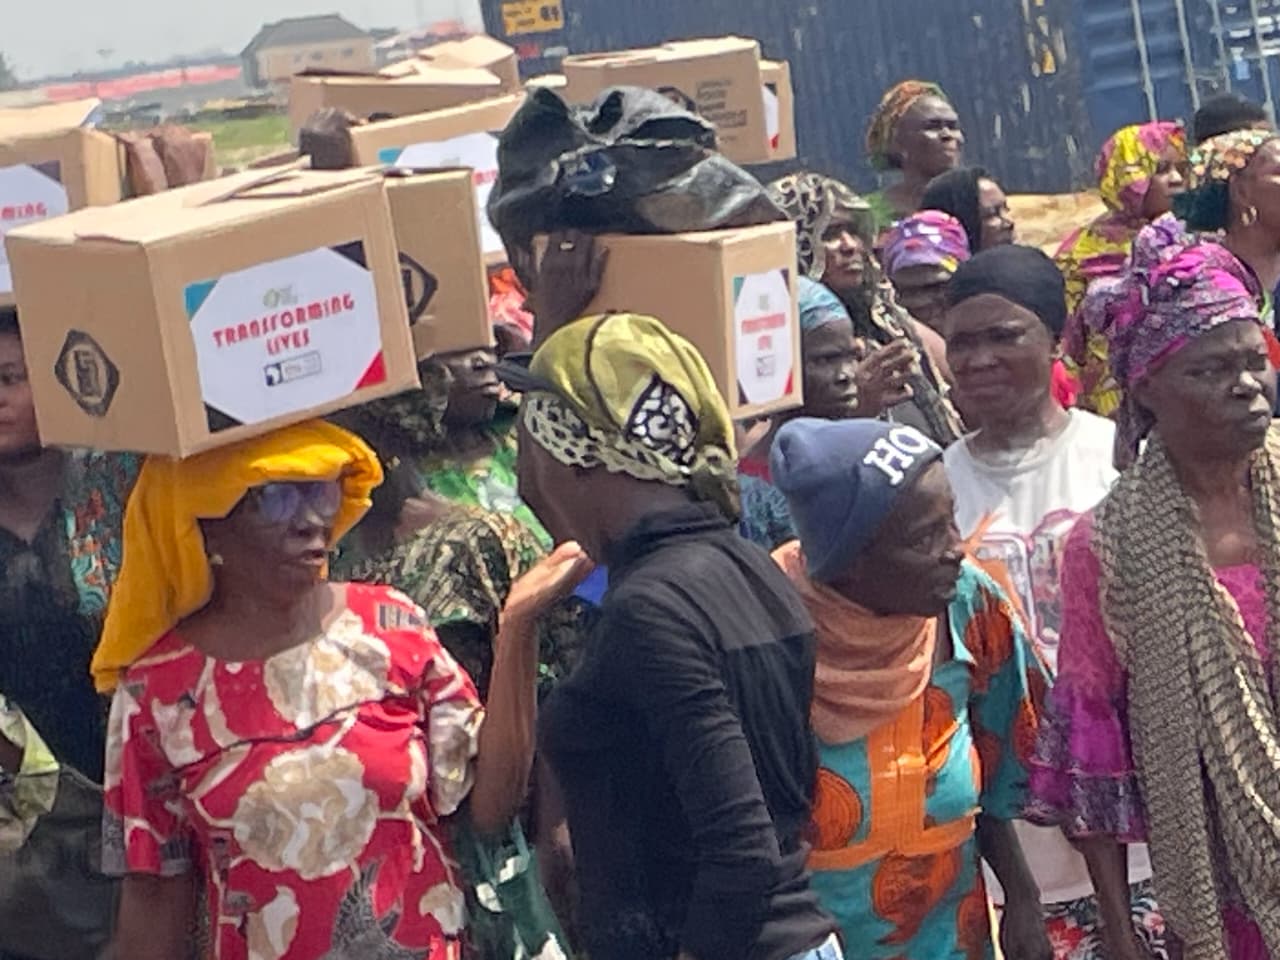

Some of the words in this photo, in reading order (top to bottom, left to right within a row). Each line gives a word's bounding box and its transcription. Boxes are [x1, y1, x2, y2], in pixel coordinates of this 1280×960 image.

[213, 294, 354, 348] TRANSFORMING
[266, 329, 310, 355] LIVES
[863, 425, 941, 485] HO
